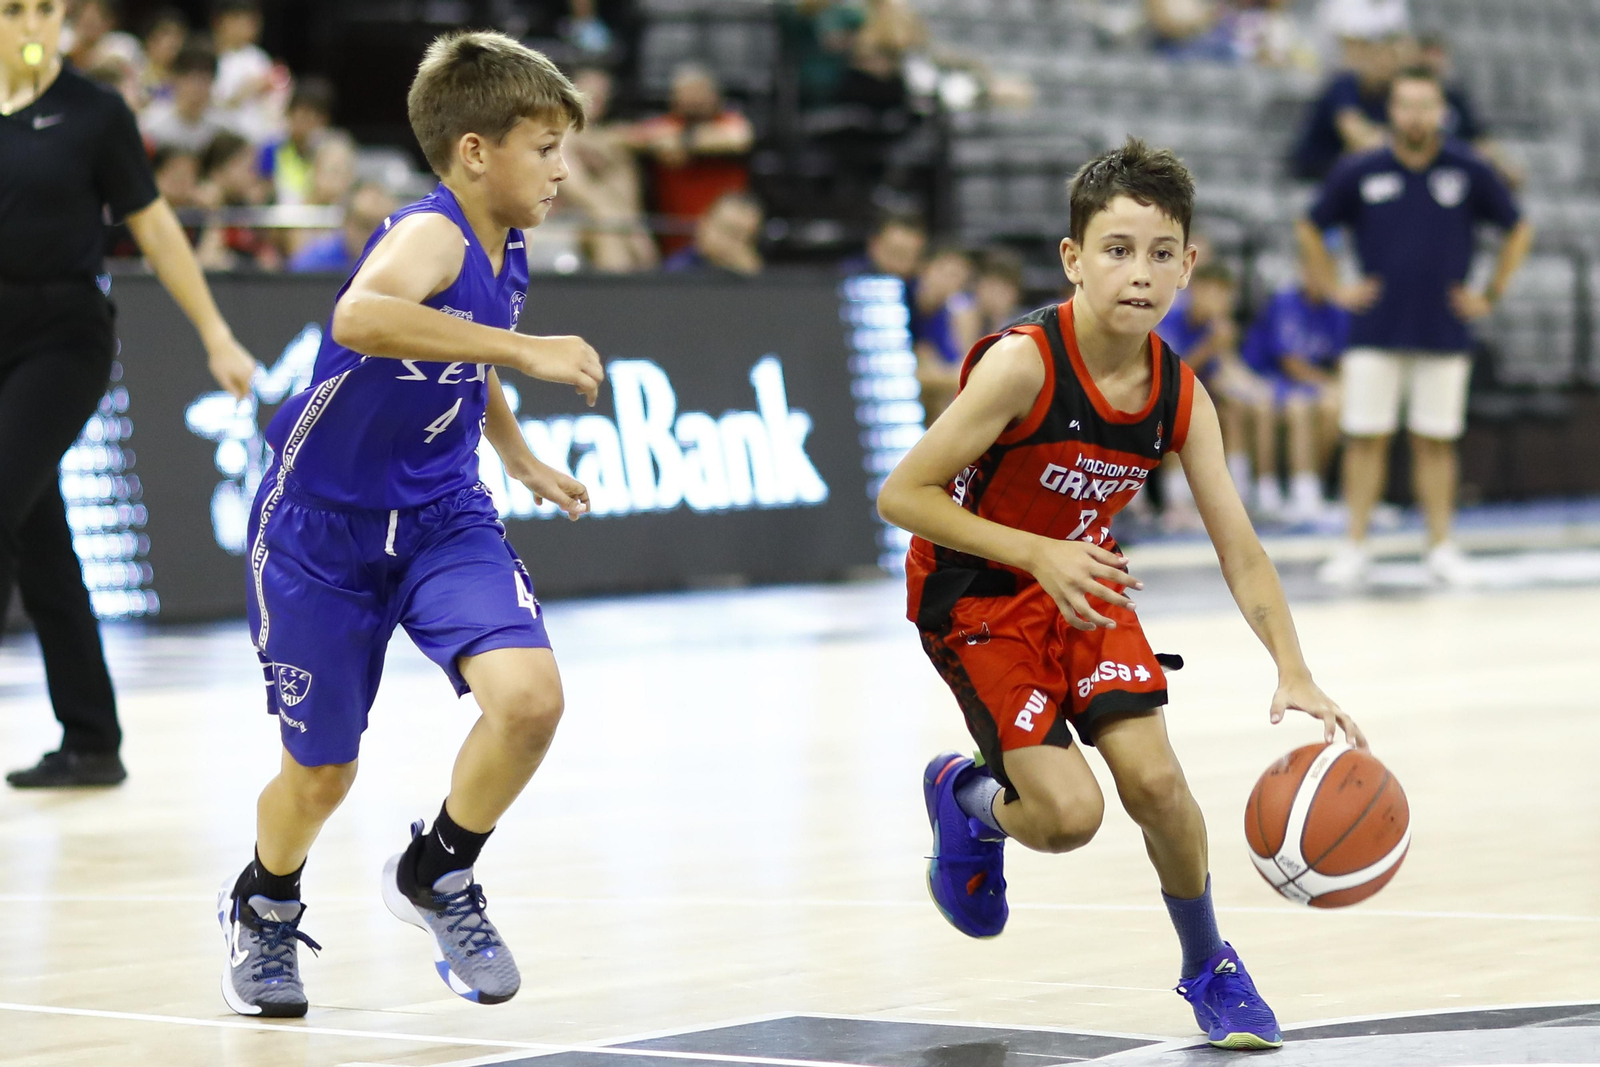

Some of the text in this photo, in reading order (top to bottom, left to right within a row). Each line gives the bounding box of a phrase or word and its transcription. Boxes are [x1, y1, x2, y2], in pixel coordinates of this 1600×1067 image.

[423, 397, 463, 444] 4
[1128, 466, 1150, 479] CB
[513, 569, 538, 620] 4
